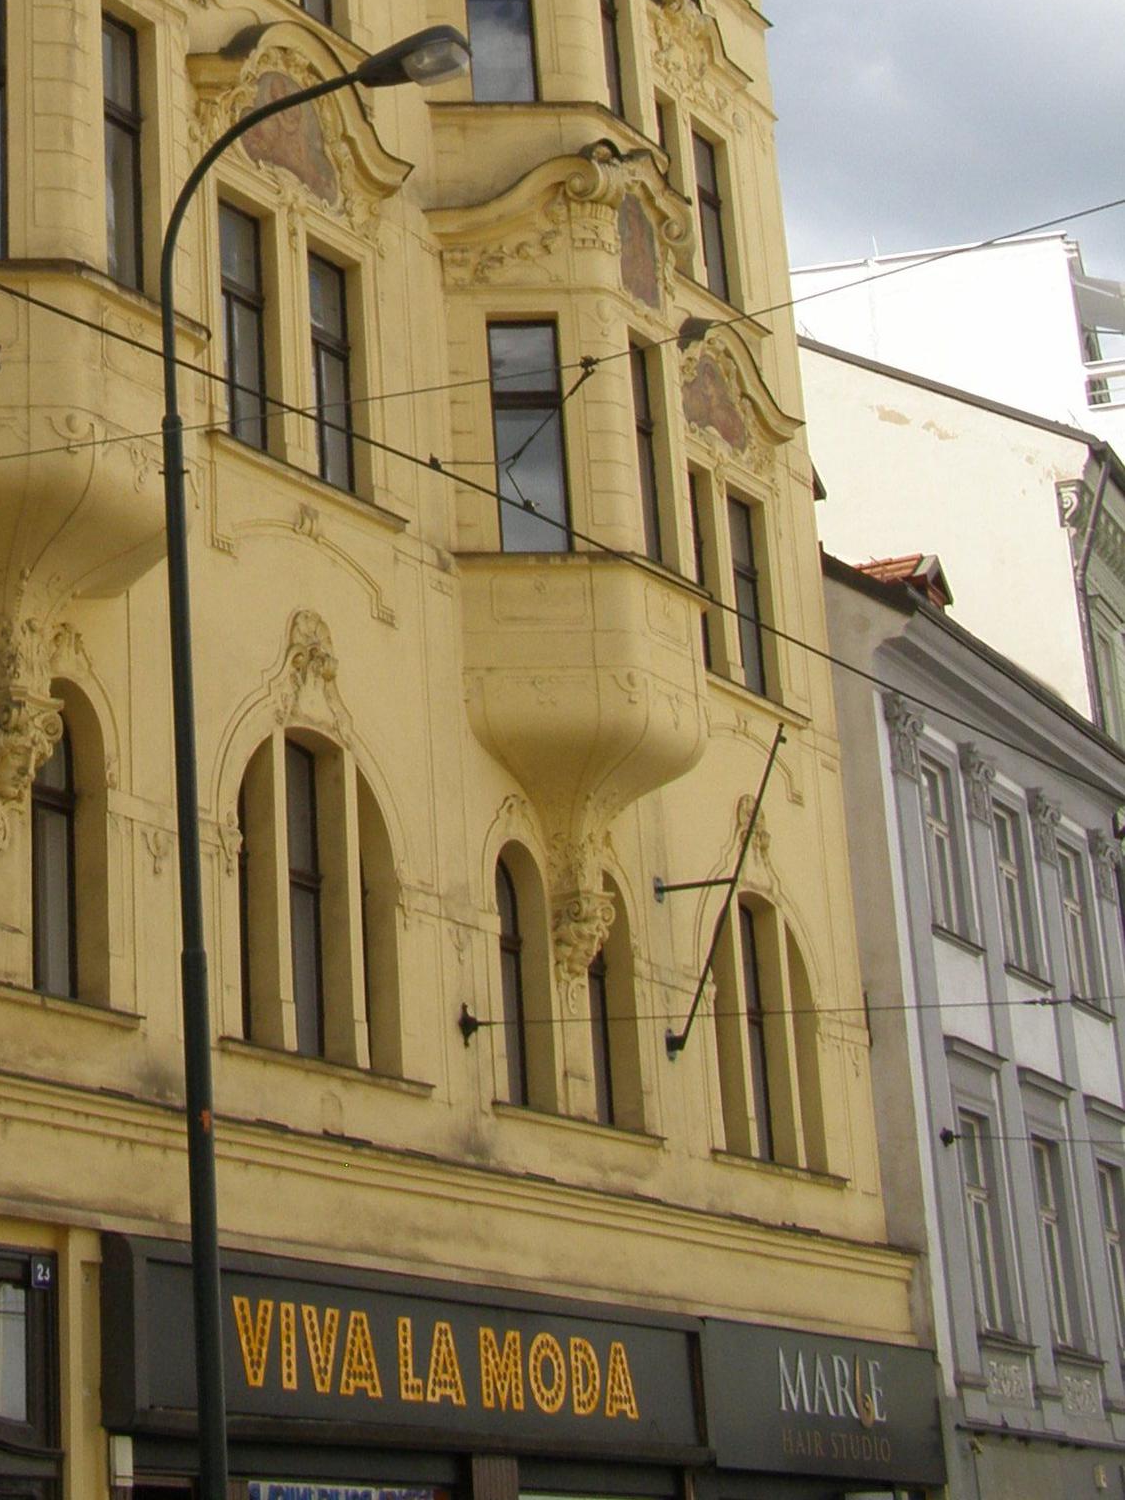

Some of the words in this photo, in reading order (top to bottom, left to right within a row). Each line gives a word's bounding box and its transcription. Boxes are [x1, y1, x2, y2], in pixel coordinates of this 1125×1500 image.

[233, 1296, 382, 1399] VIVA
[397, 1316, 467, 1406] LA
[479, 1327, 639, 1420] MODA
[782, 1427, 826, 1458] HAIR
[830, 1431, 893, 1463] STUDIO
